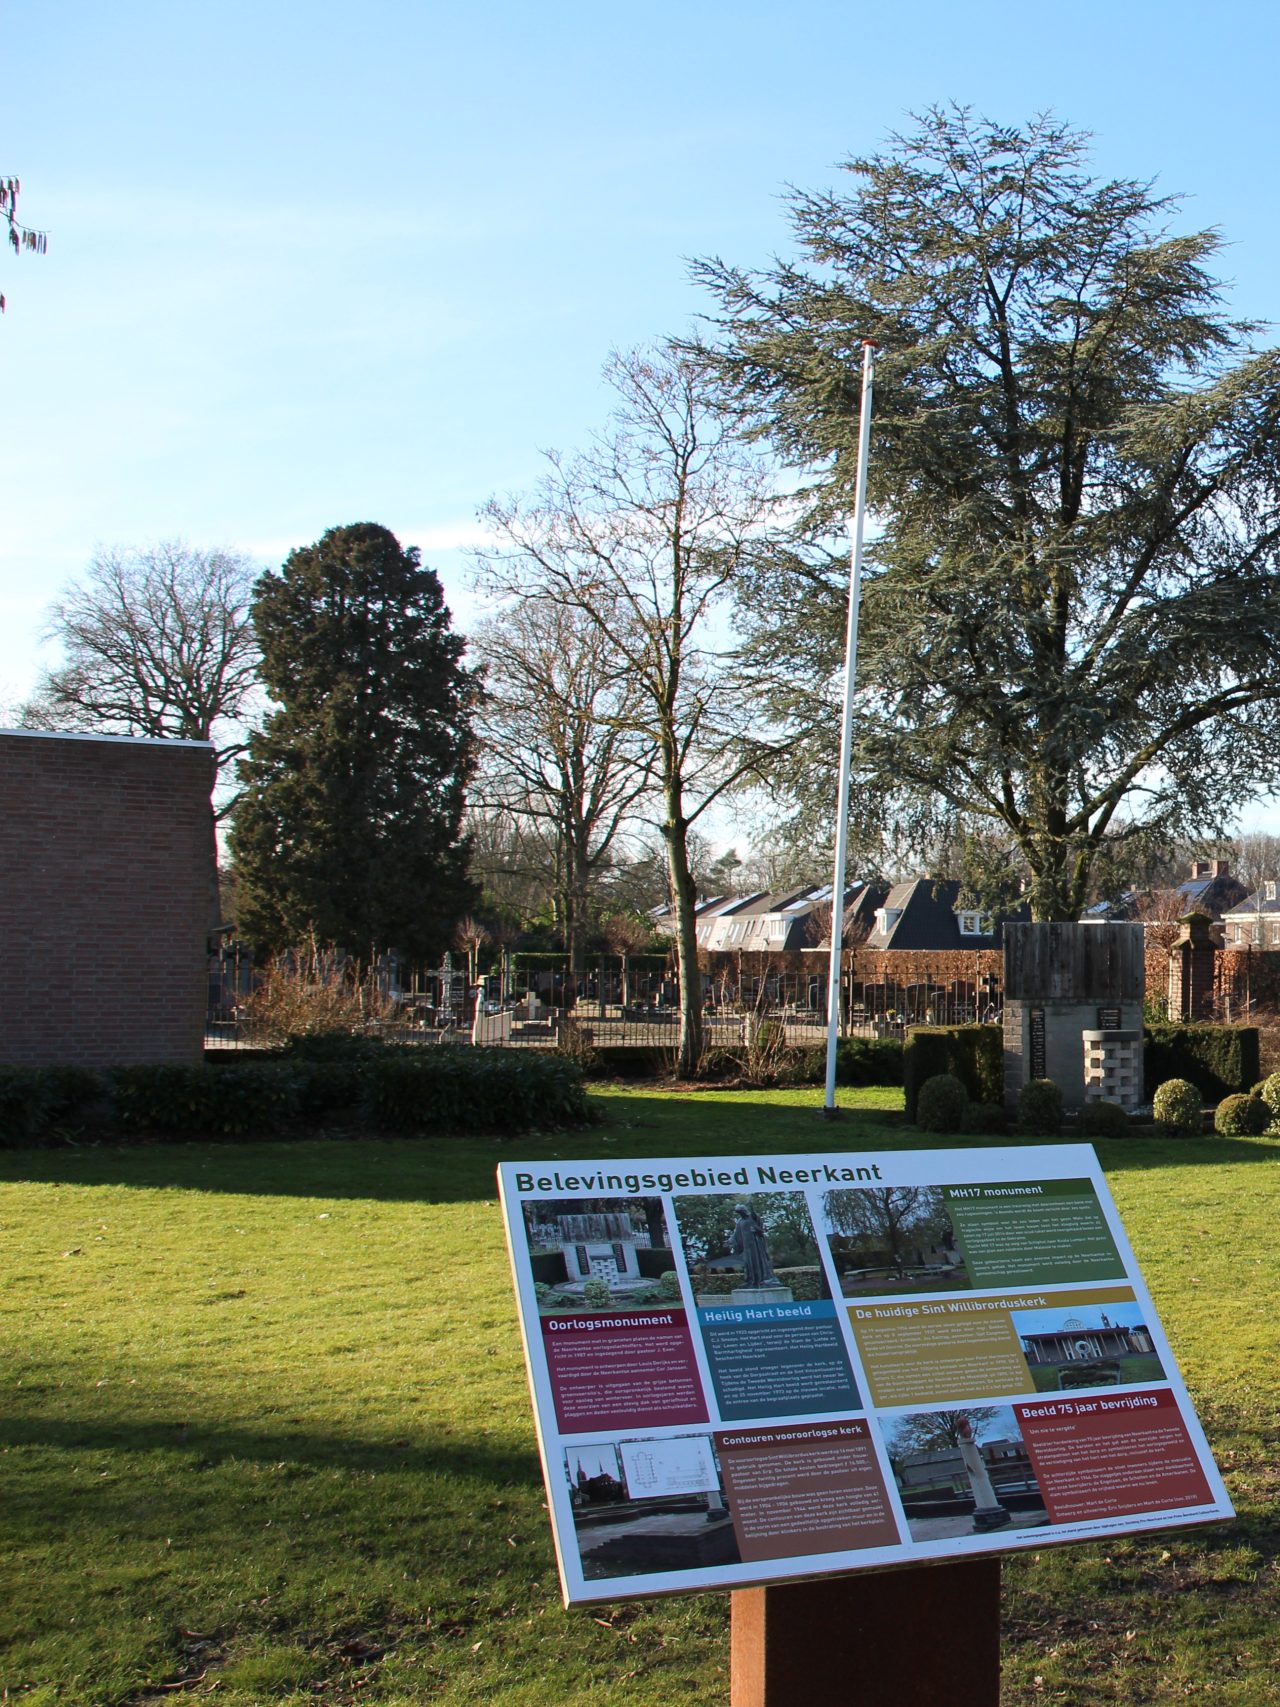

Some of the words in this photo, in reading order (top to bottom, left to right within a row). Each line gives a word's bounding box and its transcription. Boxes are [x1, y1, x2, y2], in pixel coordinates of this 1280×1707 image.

[516, 1167, 749, 1193] Belevingsgebied
[758, 1164, 882, 1186] Neerkant
[950, 1188, 980, 1198] MH17
[984, 1186, 1043, 1196] monument
[705, 1310, 742, 1322] Heilig
[746, 1308, 773, 1318] Hart
[778, 1306, 812, 1316] beeld
[856, 1309, 872, 1319] De
[876, 1306, 920, 1318] huidige
[922, 1303, 945, 1314] Sint
[947, 1297, 1047, 1312] Willibrorduskerk
[550, 1314, 672, 1330] Oorlogsmonument
[1022, 1406, 1056, 1418] Beeld
[1058, 1404, 1073, 1414] 75
[1074, 1402, 1098, 1414] jaar
[1100, 1396, 1158, 1410] bevrijding
[722, 1436, 774, 1445] Contouren
[776, 1429, 838, 1441] vooroorlogse
[840, 1426, 862, 1434] kerk
